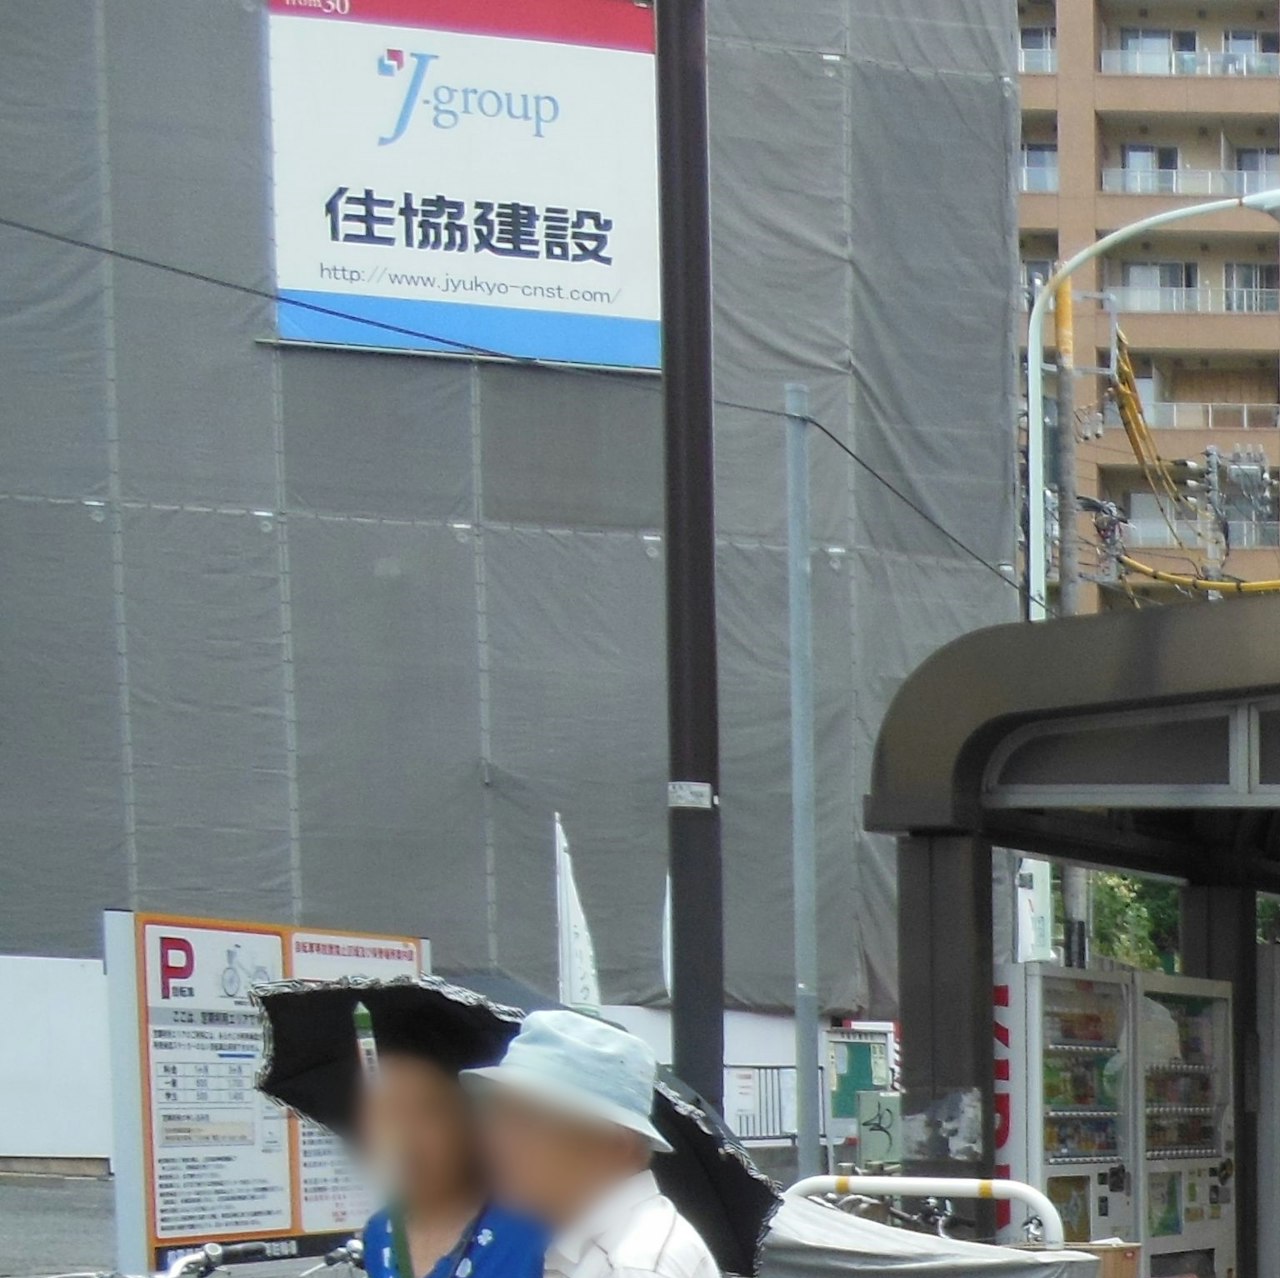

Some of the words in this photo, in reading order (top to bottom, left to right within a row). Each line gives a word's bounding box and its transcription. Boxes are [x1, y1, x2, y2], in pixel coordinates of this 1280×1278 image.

[378, 52, 559, 146] J-group
[325, 187, 613, 265] 住協建設
[320, 262, 622, 304] http://www.jyukyo-cnst.com/
[160, 936, 194, 999] P
